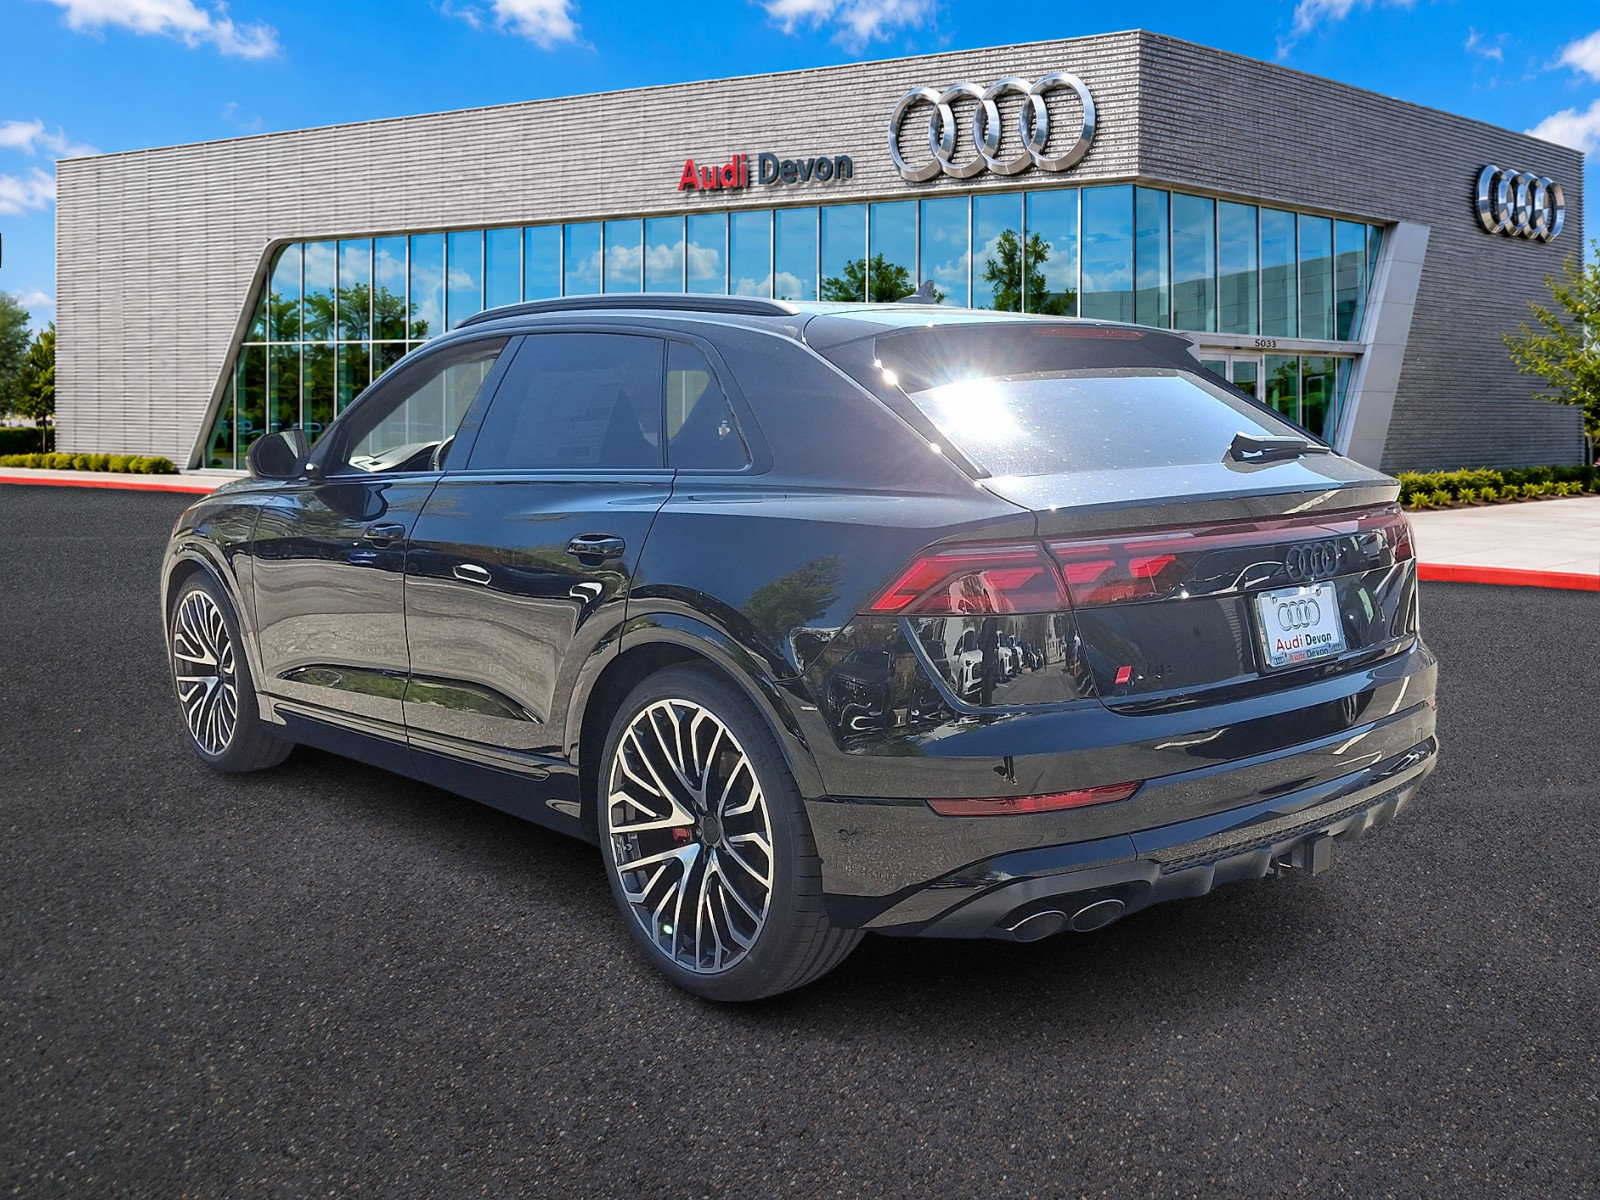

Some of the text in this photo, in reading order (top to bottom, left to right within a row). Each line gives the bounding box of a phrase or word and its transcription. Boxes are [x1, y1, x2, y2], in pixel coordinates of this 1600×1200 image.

[678, 152, 853, 191] Audi Devon
[1254, 339, 1277, 348] 5033
[1276, 633, 1332, 652] Audi Devon
[1307, 648, 1329, 658] Devon
